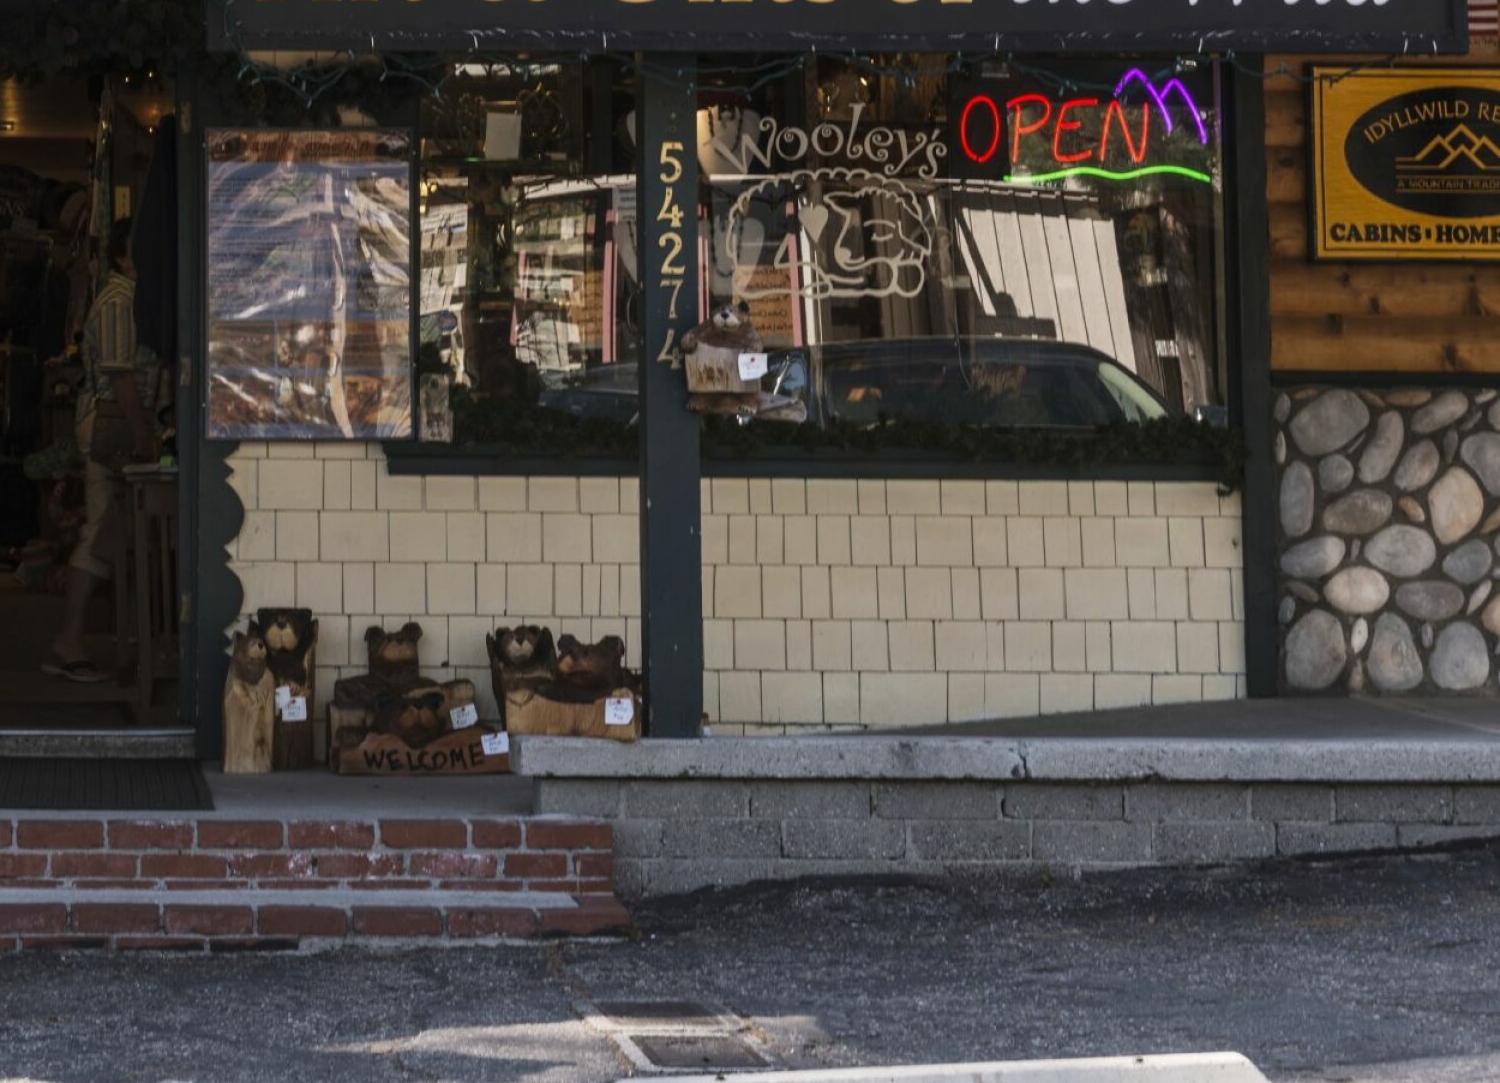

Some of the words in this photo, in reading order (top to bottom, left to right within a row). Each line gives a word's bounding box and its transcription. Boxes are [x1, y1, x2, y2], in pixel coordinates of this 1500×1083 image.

[703, 101, 947, 179] Wooley's
[960, 94, 1150, 164] OPEN
[1363, 100, 1469, 144] IDYLLWILD
[1409, 179, 1464, 190] MOUNTAIN
[1330, 223, 1421, 243] CABINS
[364, 742, 485, 772] WELCOME
